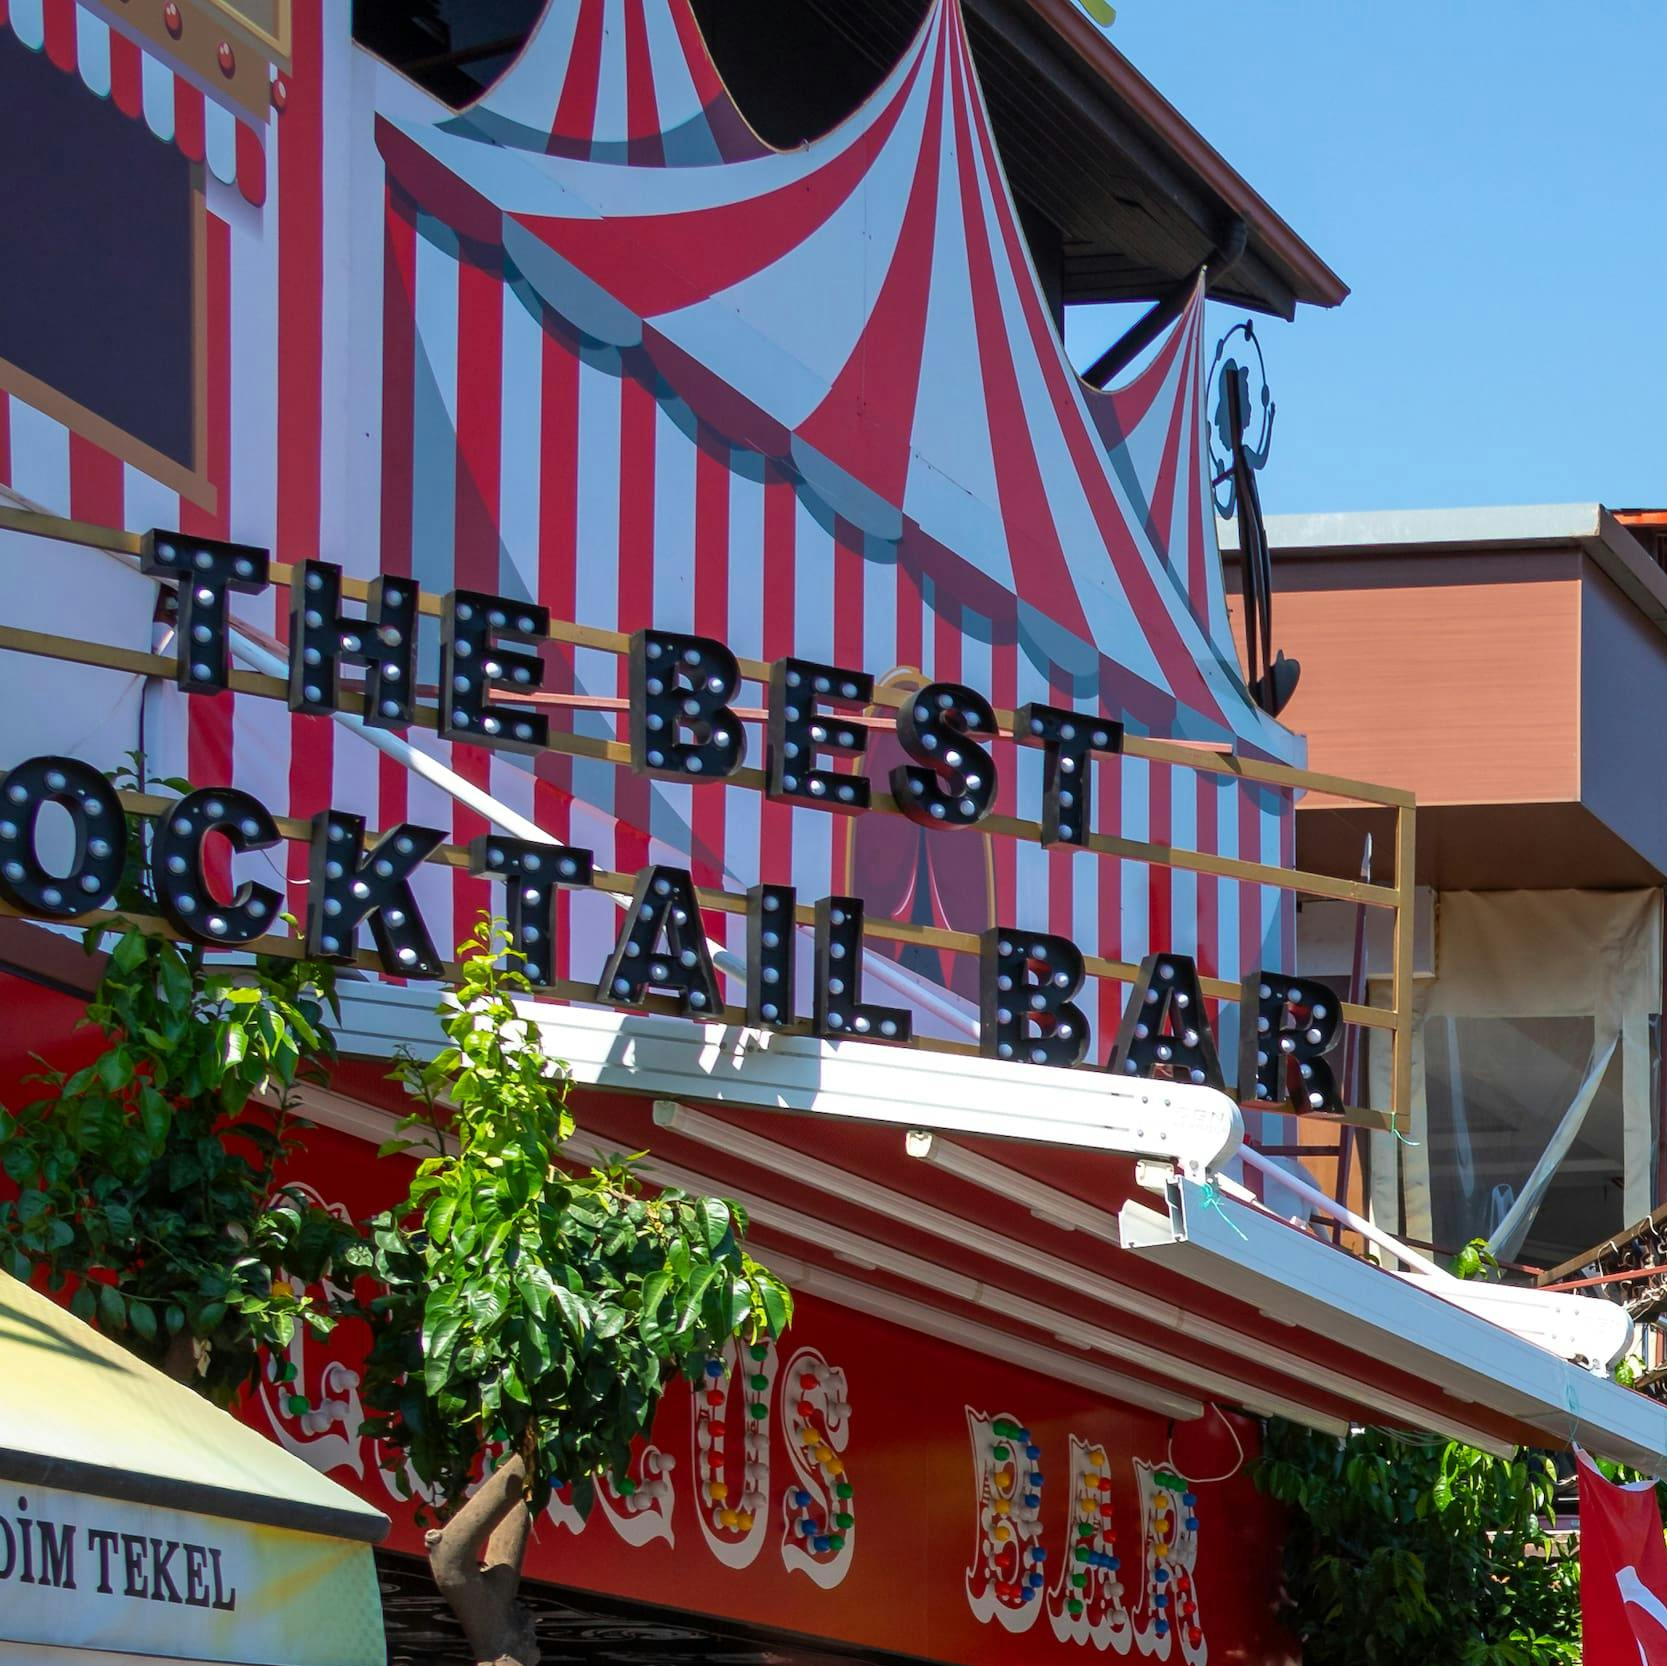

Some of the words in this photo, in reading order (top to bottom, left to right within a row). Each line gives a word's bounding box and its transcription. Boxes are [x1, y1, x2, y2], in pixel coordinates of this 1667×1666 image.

[141, 526, 551, 755] THE
[628, 628, 1123, 848] BEST
[0, 755, 912, 1048] OCKTAIL
[979, 925, 1346, 1118] BAR
[87, 1528, 236, 1612] TEKEL
